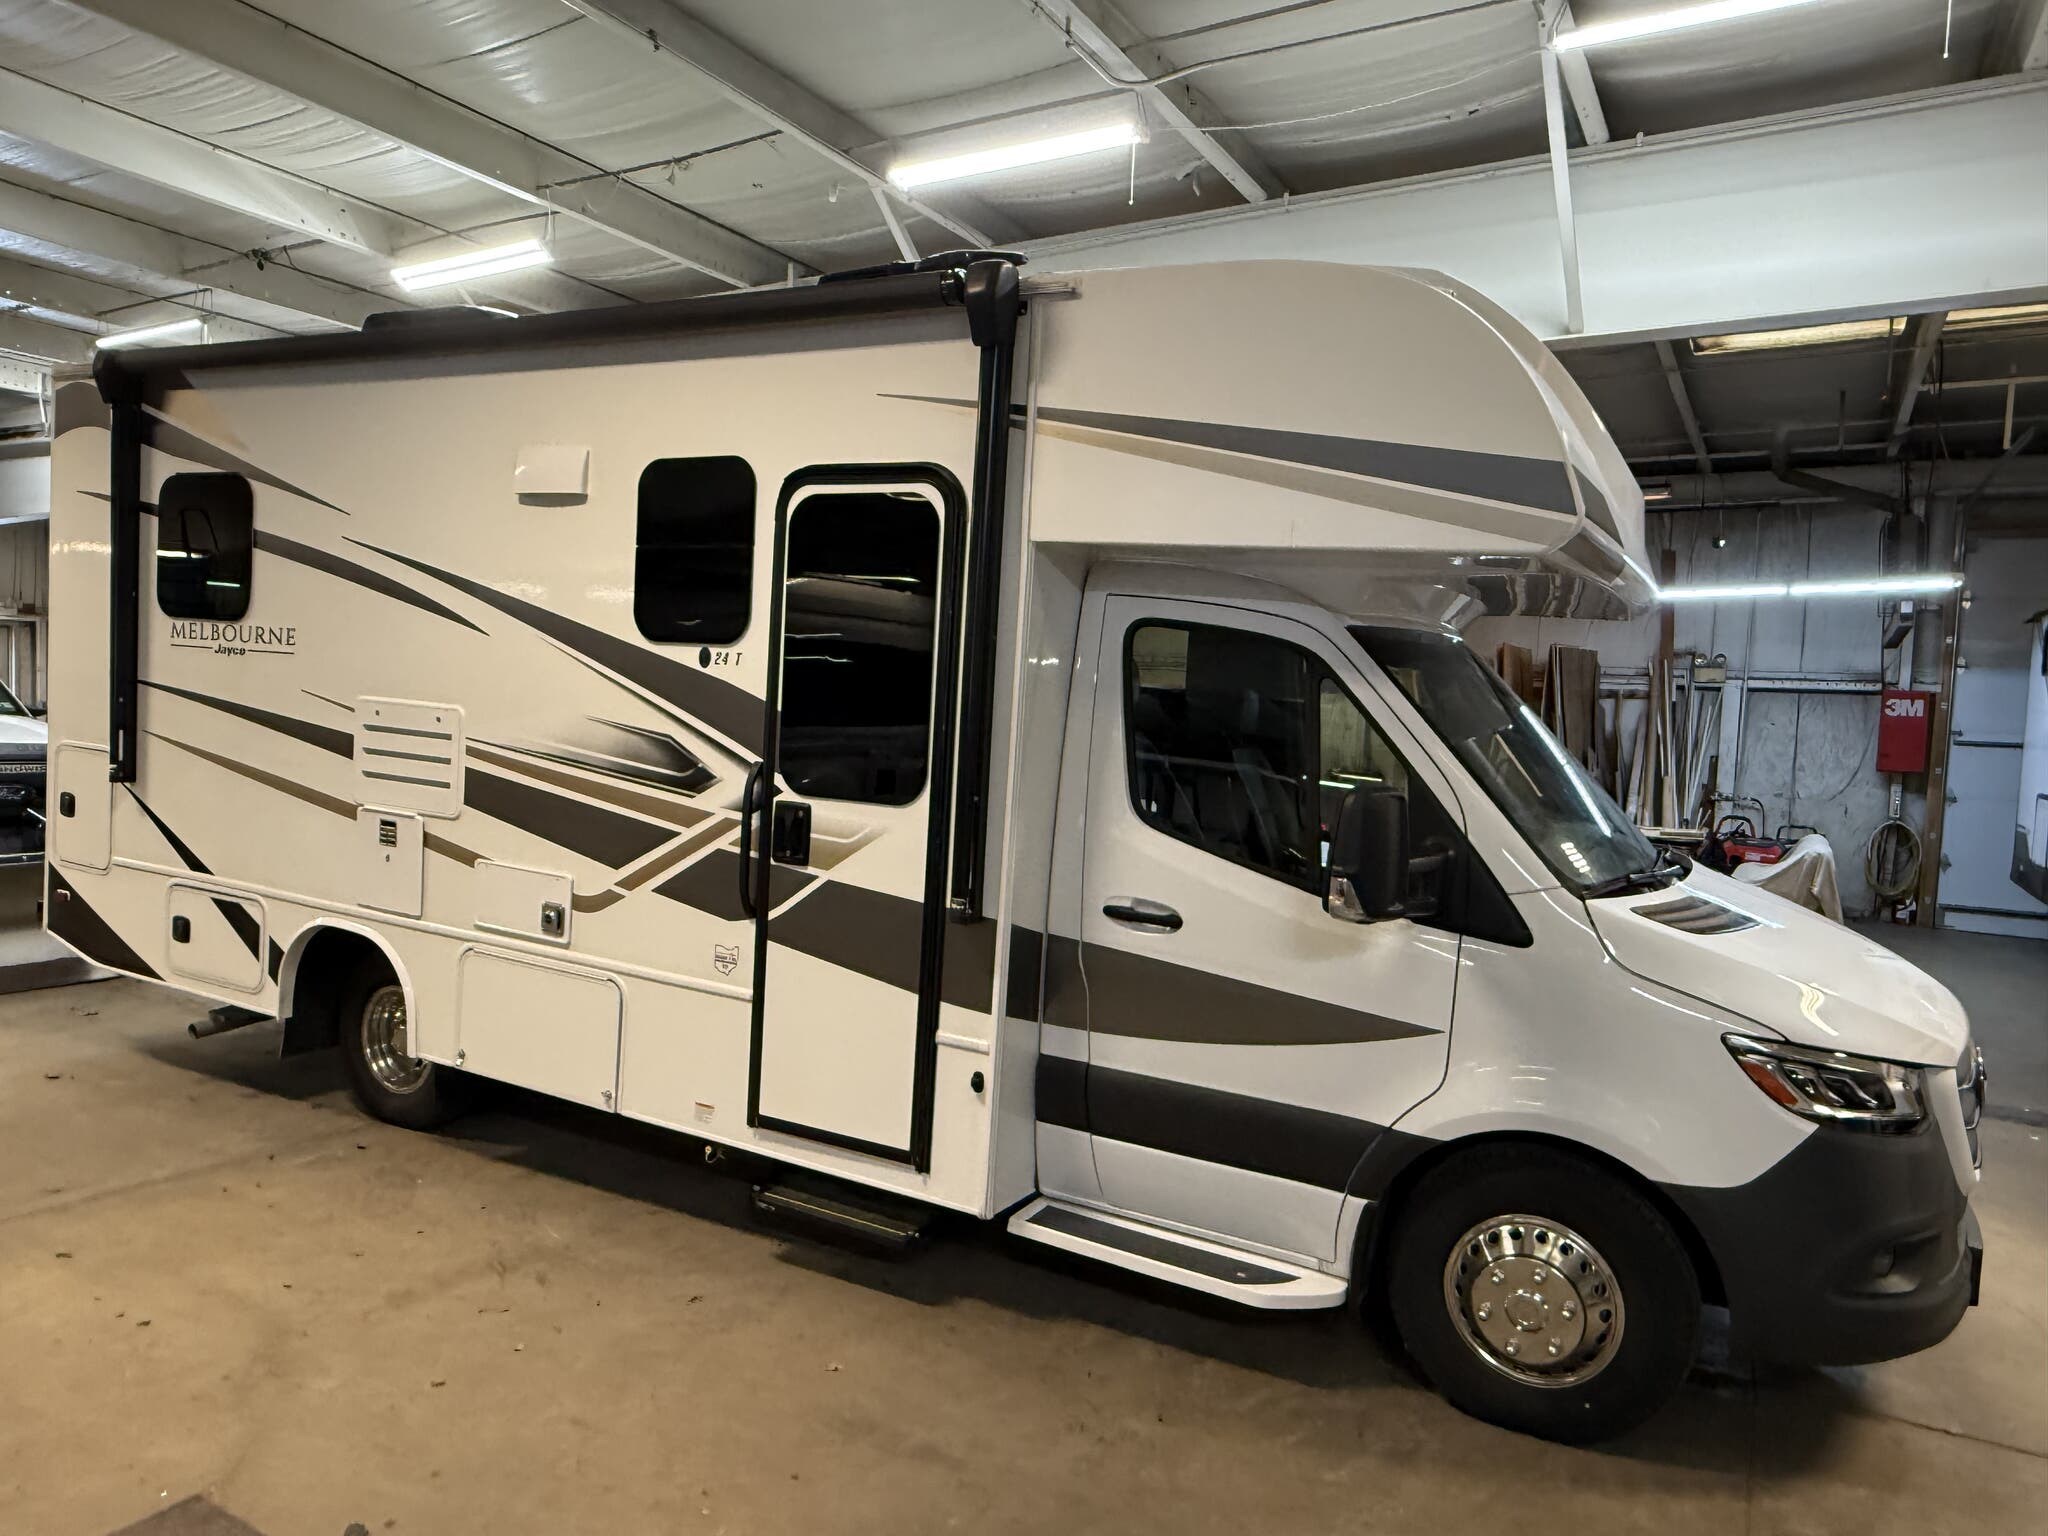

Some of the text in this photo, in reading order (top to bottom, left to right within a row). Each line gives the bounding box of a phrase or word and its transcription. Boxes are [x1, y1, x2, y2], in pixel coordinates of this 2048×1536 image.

[170, 621, 296, 646] MELBOURNE
[214, 644, 246, 656] Jayco
[714, 651, 729, 666] 24
[1884, 698, 1925, 717] 3M
